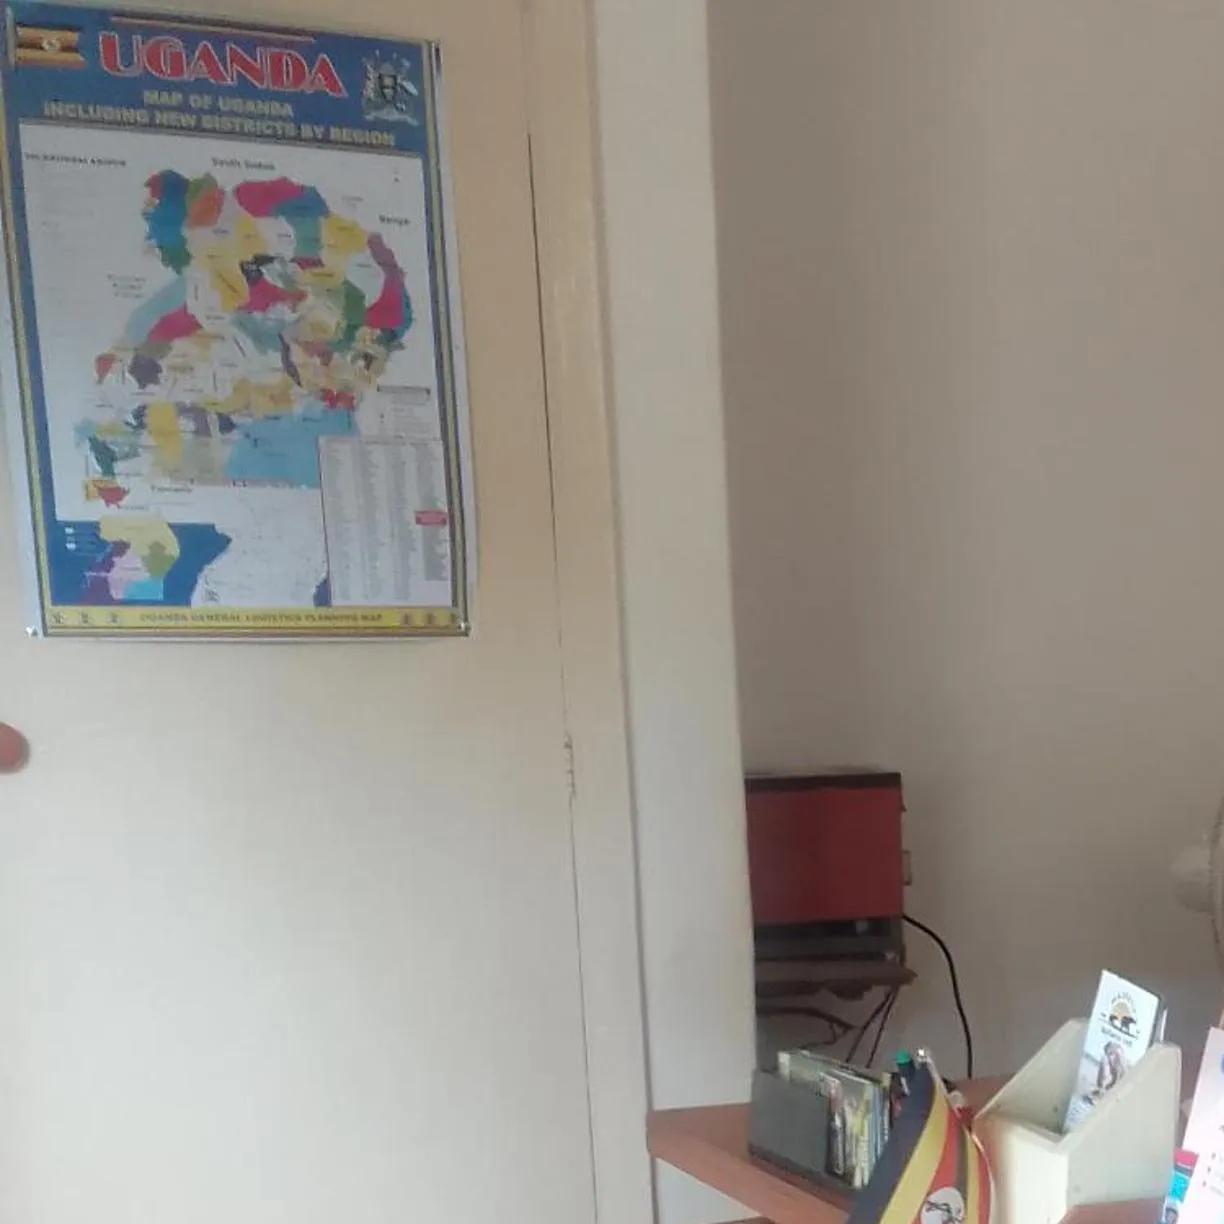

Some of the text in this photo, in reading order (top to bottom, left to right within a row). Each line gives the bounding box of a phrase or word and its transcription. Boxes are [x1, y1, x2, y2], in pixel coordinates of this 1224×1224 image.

[99, 31, 349, 97] UGANDA
[143, 90, 184, 106] MAP
[189, 94, 212, 108] OF
[44, 101, 395, 147] INCLUDING NEW DISTRICTS BY REGION
